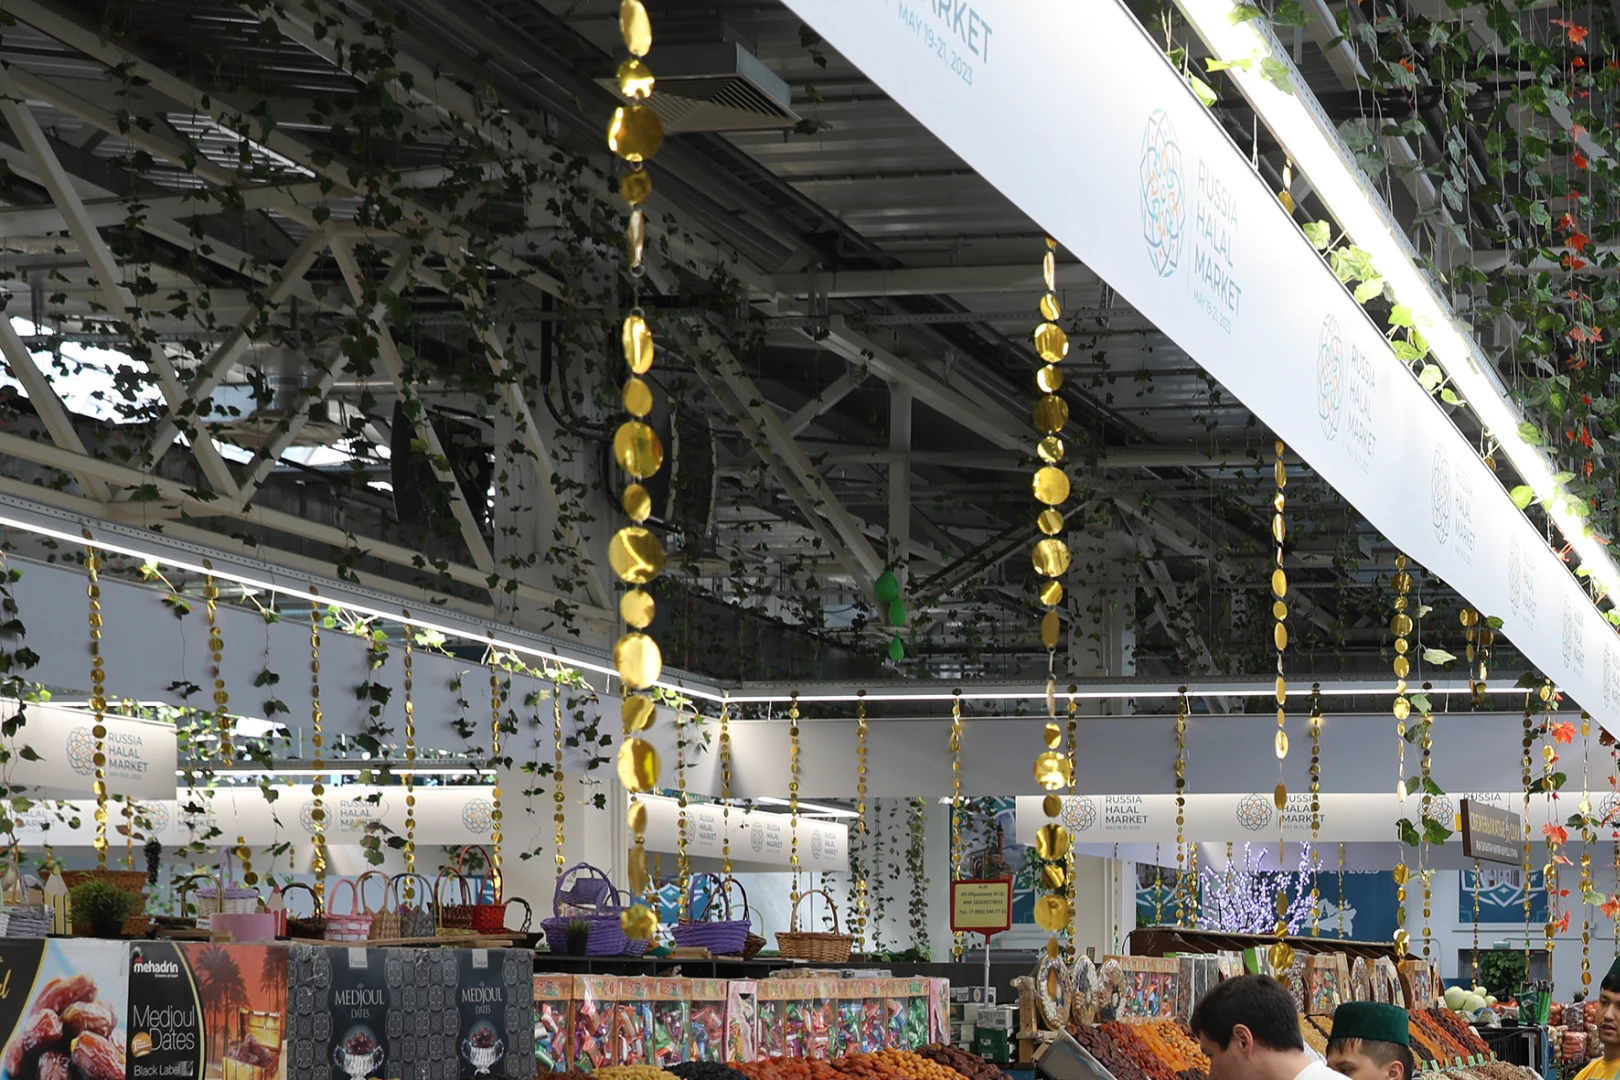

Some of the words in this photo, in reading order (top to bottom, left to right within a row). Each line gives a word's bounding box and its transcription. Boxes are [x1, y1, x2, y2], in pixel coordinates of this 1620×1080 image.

[931, 0, 993, 64] RKET
[899, 2, 922, 36] MAY
[951, 50, 974, 86] 2023
[1198, 157, 1239, 232] RUSSIA
[1196, 200, 1234, 268] HALAL
[1194, 243, 1242, 316] MARKET
[1352, 344, 1376, 393] RUSSIA
[1350, 376, 1372, 423] HALAL
[1348, 409, 1376, 460] MARKET
[108, 732, 143, 746] RUSSIA
[108, 746, 140, 759] HALAL
[108, 759, 148, 772] MARKET
[1105, 796, 1143, 804] RUSSIA
[1105, 806, 1139, 814] HALAL
[1105, 815, 1148, 824] MARKET
[700, 832, 717, 841] MARKET
[134, 960, 178, 973] mehadrin
[334, 989, 385, 1008] MEDJOUL
[462, 988, 503, 1004] MEDJOUL
[133, 1004, 195, 1032] Medjoul
[351, 1008, 370, 1018] DATES
[475, 1006, 491, 1014] DATES
[150, 1028, 195, 1050] Dates
[134, 1064, 158, 1076] Black
[160, 1063, 180, 1076] Label
